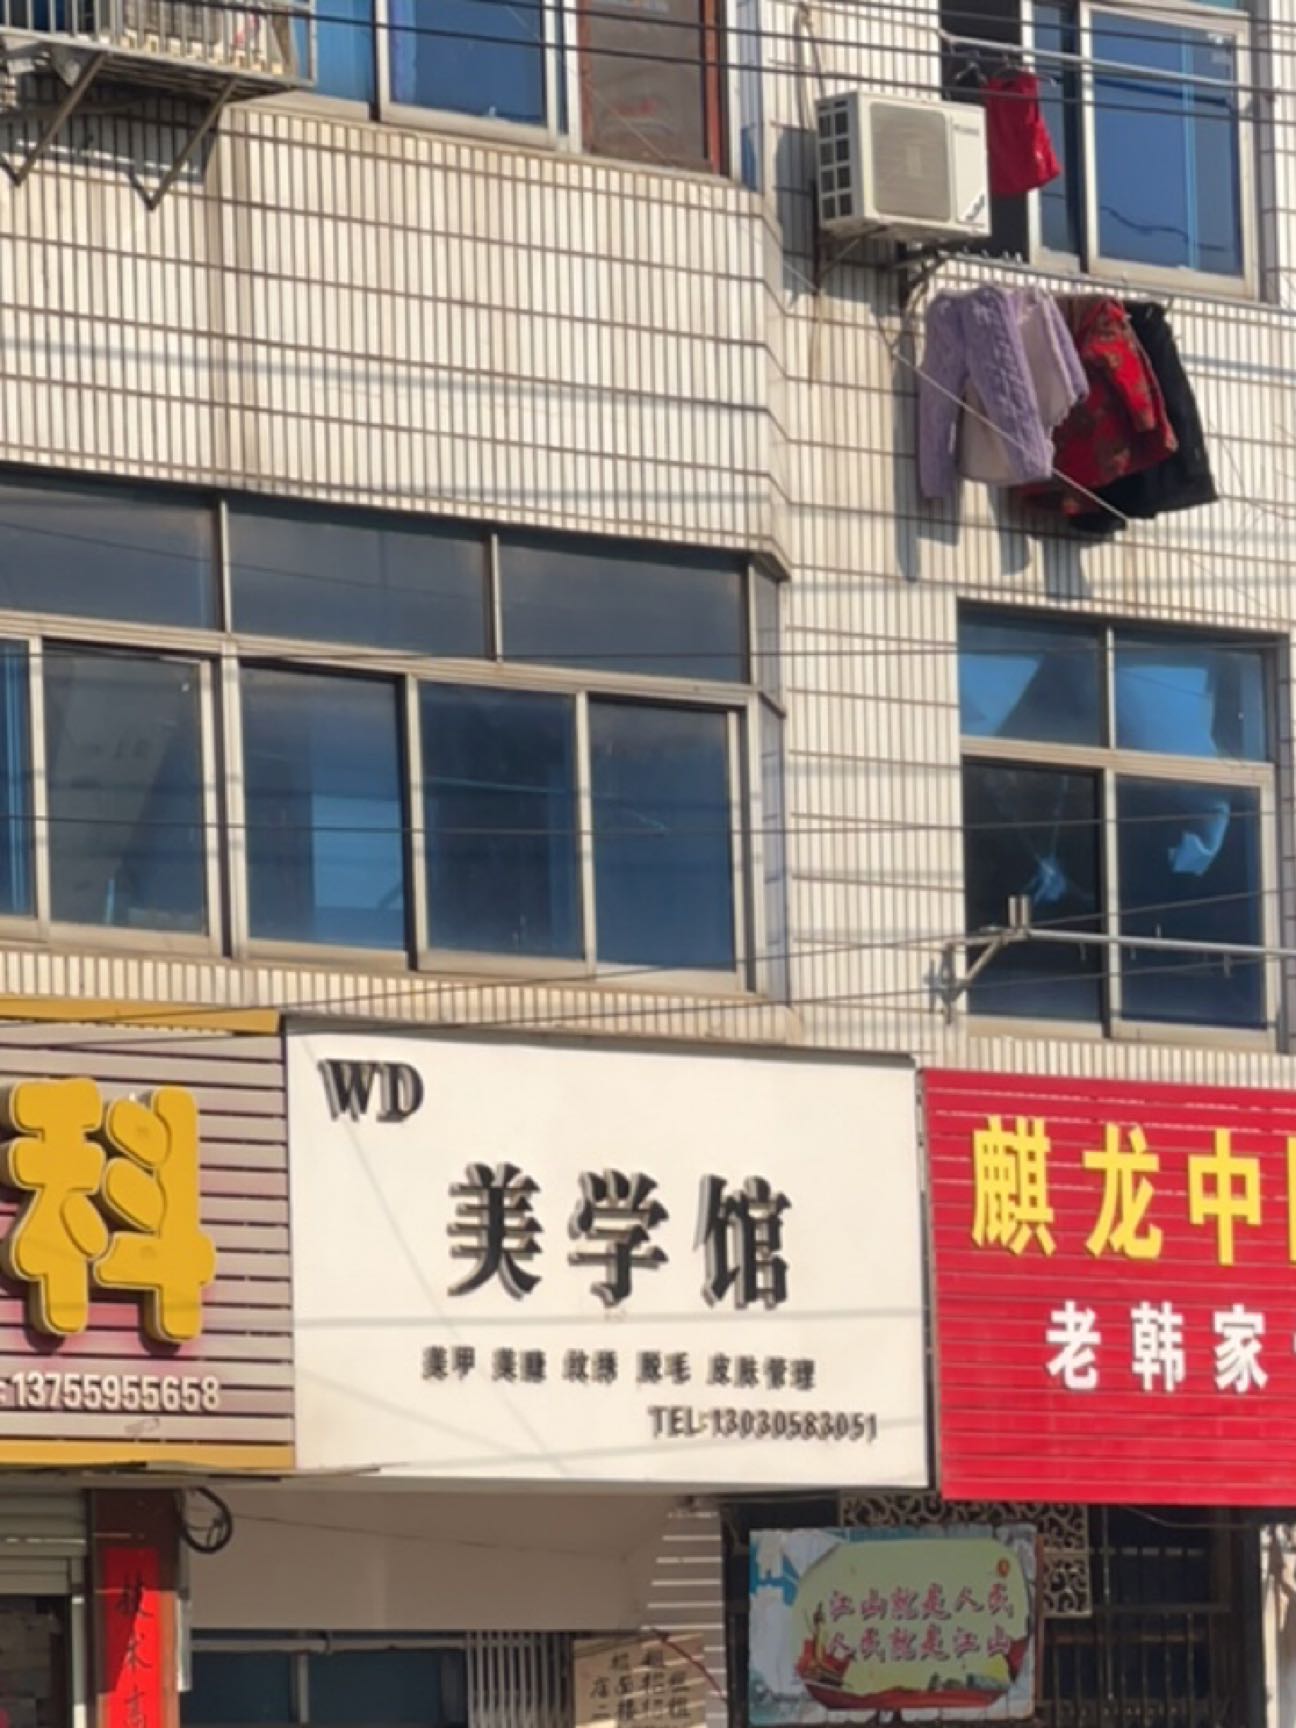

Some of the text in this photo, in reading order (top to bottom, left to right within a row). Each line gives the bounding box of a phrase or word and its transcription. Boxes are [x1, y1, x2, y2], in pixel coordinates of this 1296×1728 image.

[318, 1058, 424, 1122] WD
[446, 1162, 792, 1310] 美学馆
